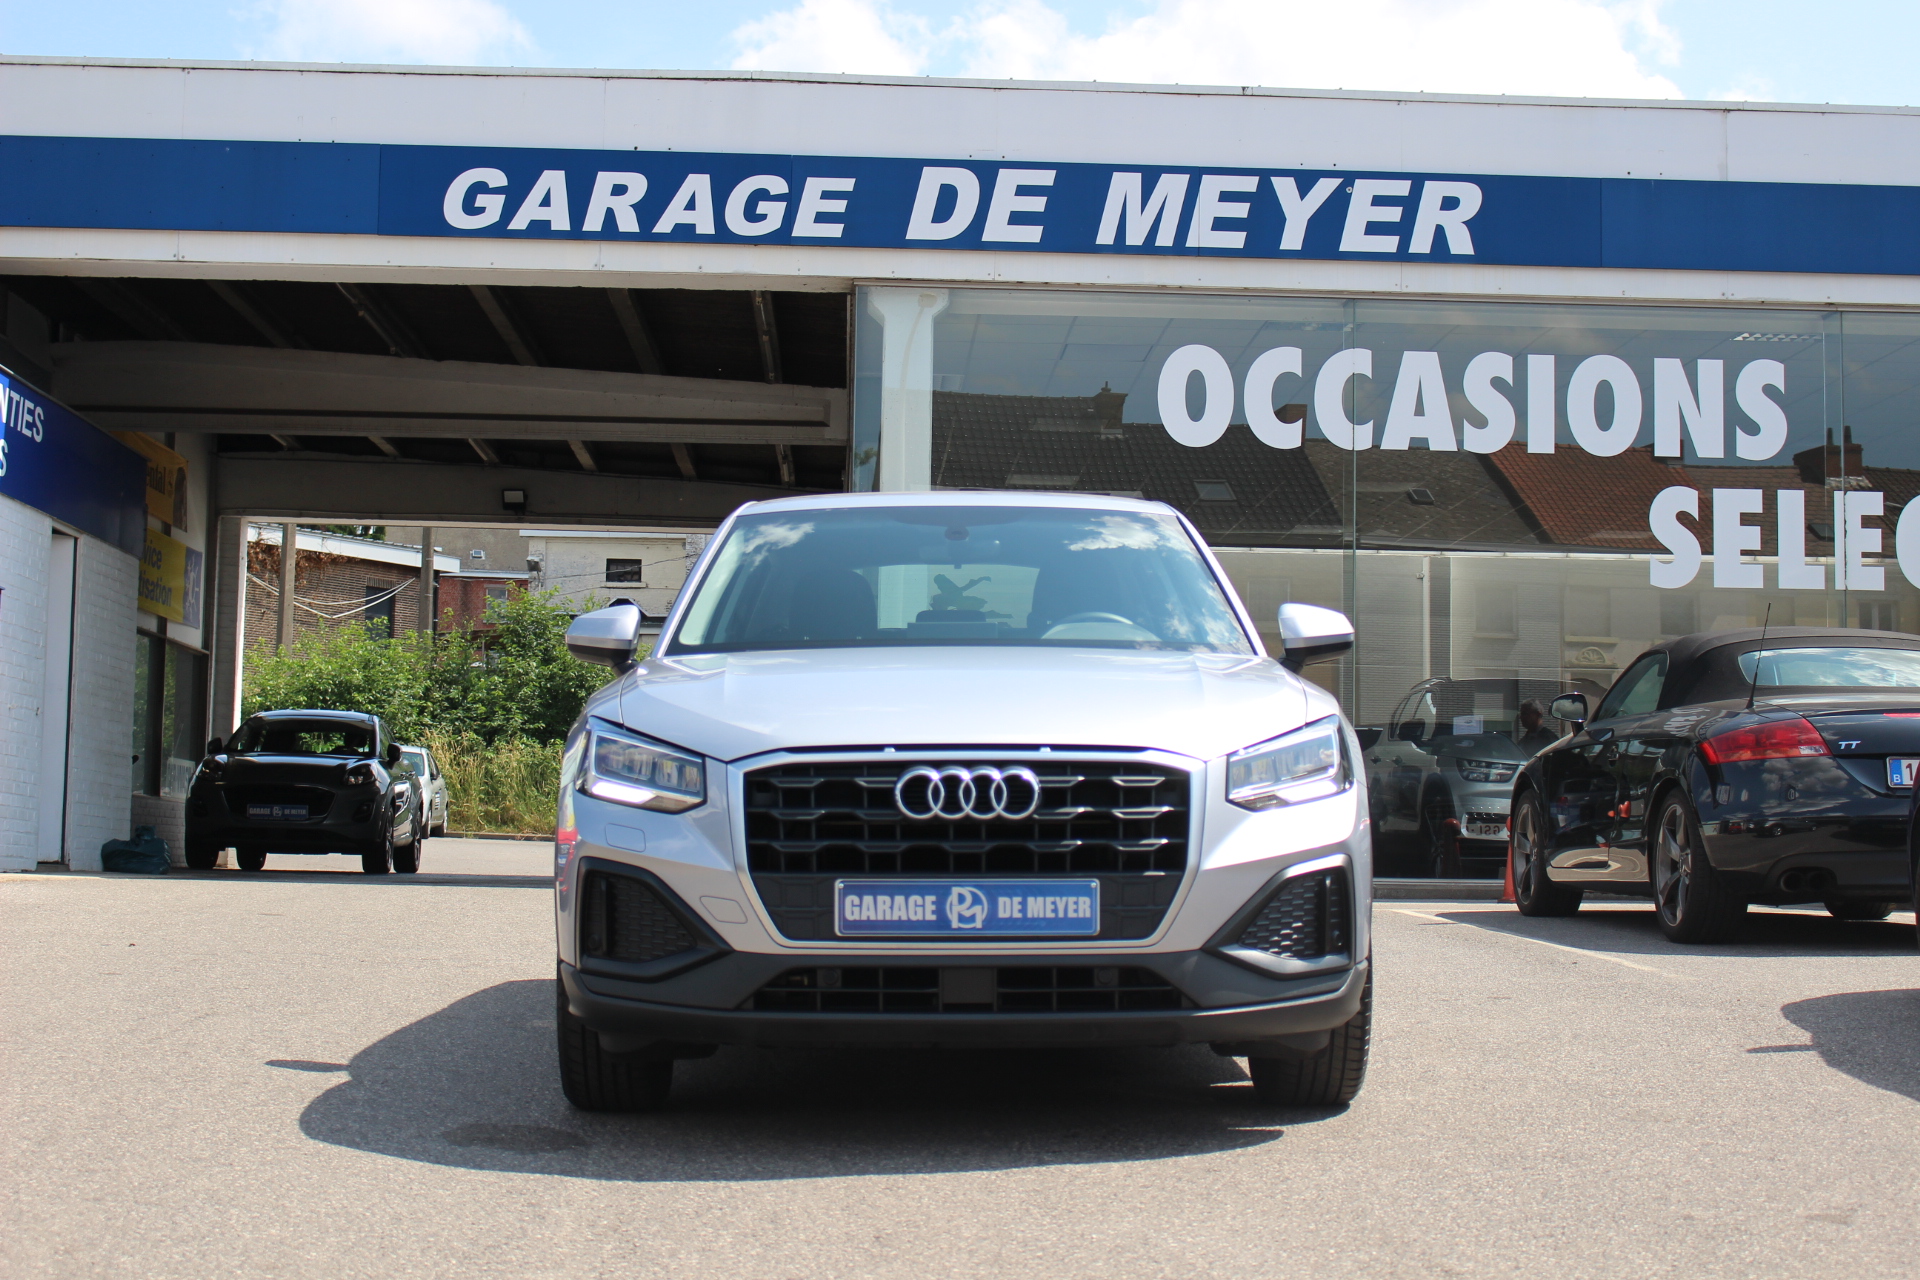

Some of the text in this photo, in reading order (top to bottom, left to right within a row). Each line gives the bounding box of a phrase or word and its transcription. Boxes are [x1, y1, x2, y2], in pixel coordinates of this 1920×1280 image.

[443, 166, 1483, 255] GARAGE DE MEYER
[1157, 344, 1789, 461] OCCASIONS
[1838, 741, 1861, 749] TT
[1893, 774, 1901, 783] B
[844, 895, 937, 921] GARAGE
[997, 897, 1023, 919] DE
[1026, 897, 1092, 919] MEYER
